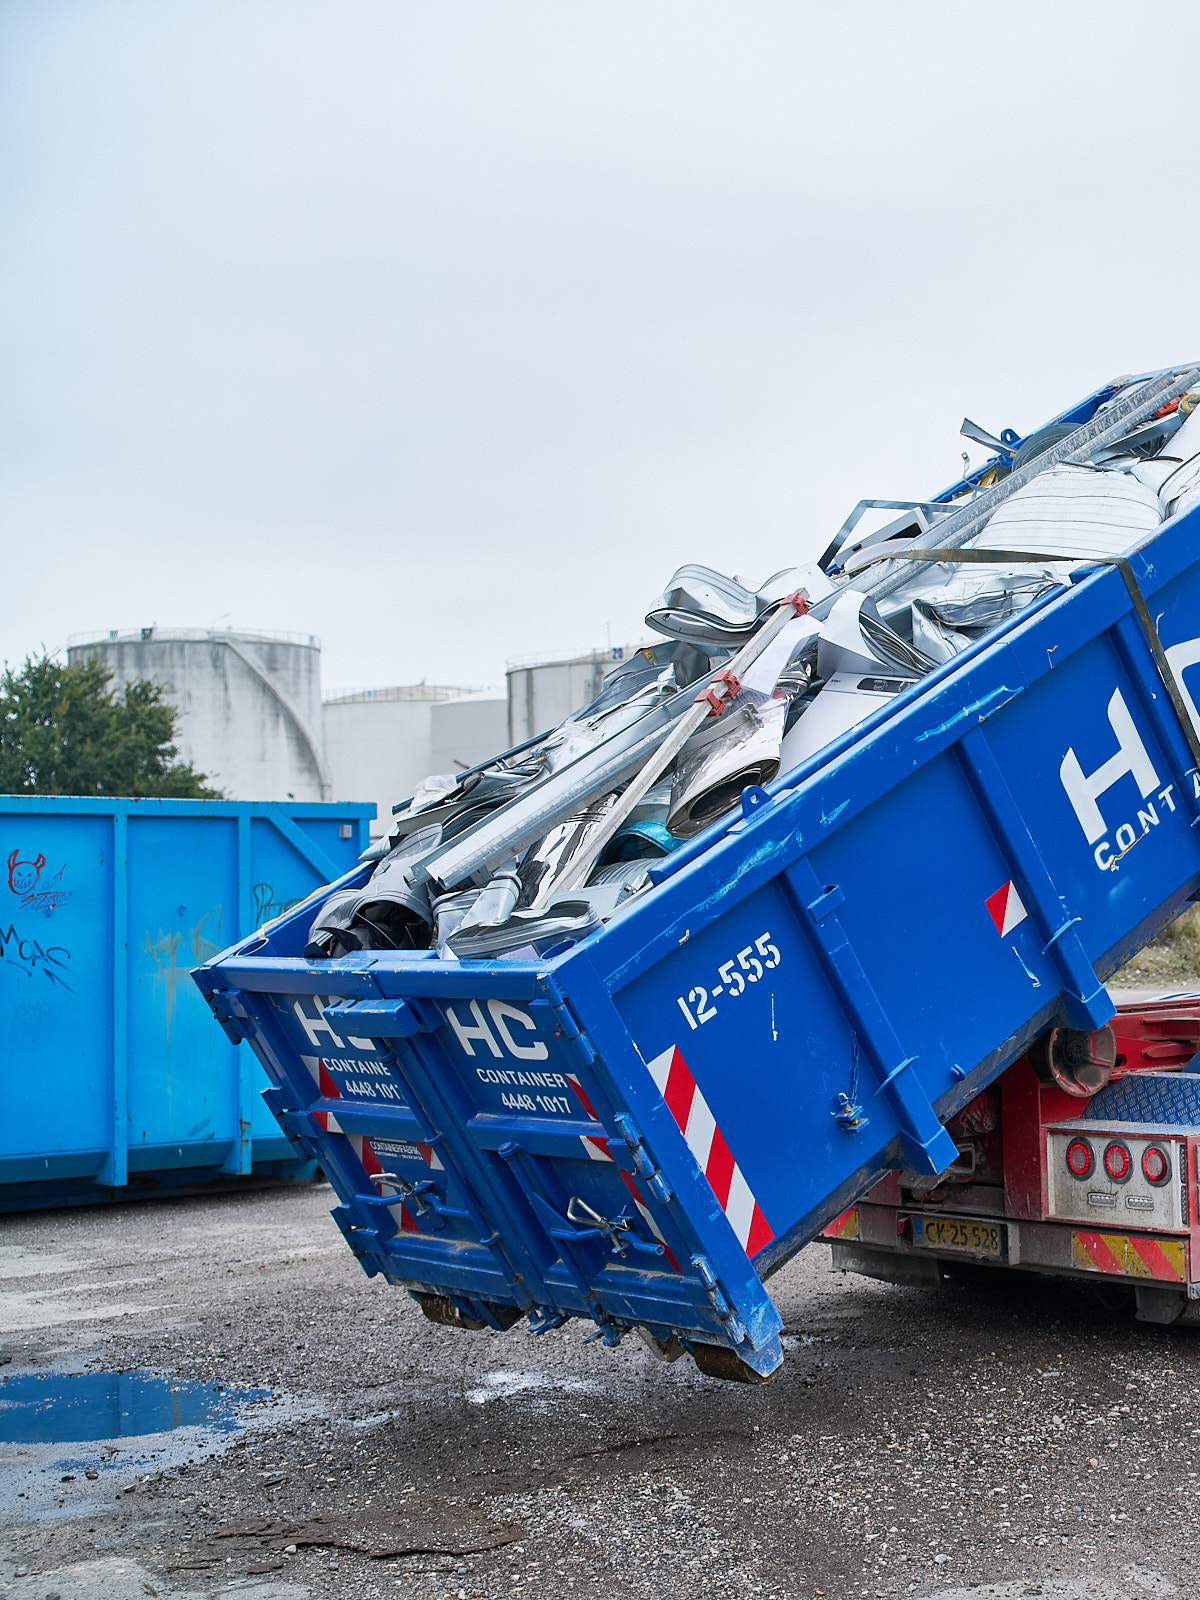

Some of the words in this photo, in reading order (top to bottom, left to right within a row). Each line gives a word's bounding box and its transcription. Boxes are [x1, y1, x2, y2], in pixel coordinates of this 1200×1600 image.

[677, 931, 781, 1031] 12-555
[446, 998, 549, 1061] HC
[322, 1057, 392, 1076] CONTAINE
[476, 1068, 569, 1088] CONTAINER
[345, 1079, 377, 1098] 4448
[375, 1082, 401, 1100] 101
[501, 1092, 537, 1112] 4448
[536, 1094, 572, 1114] 1017
[925, 1222, 947, 1244] CK
[949, 1224, 969, 1246] 25
[972, 1226, 999, 1251] 528
